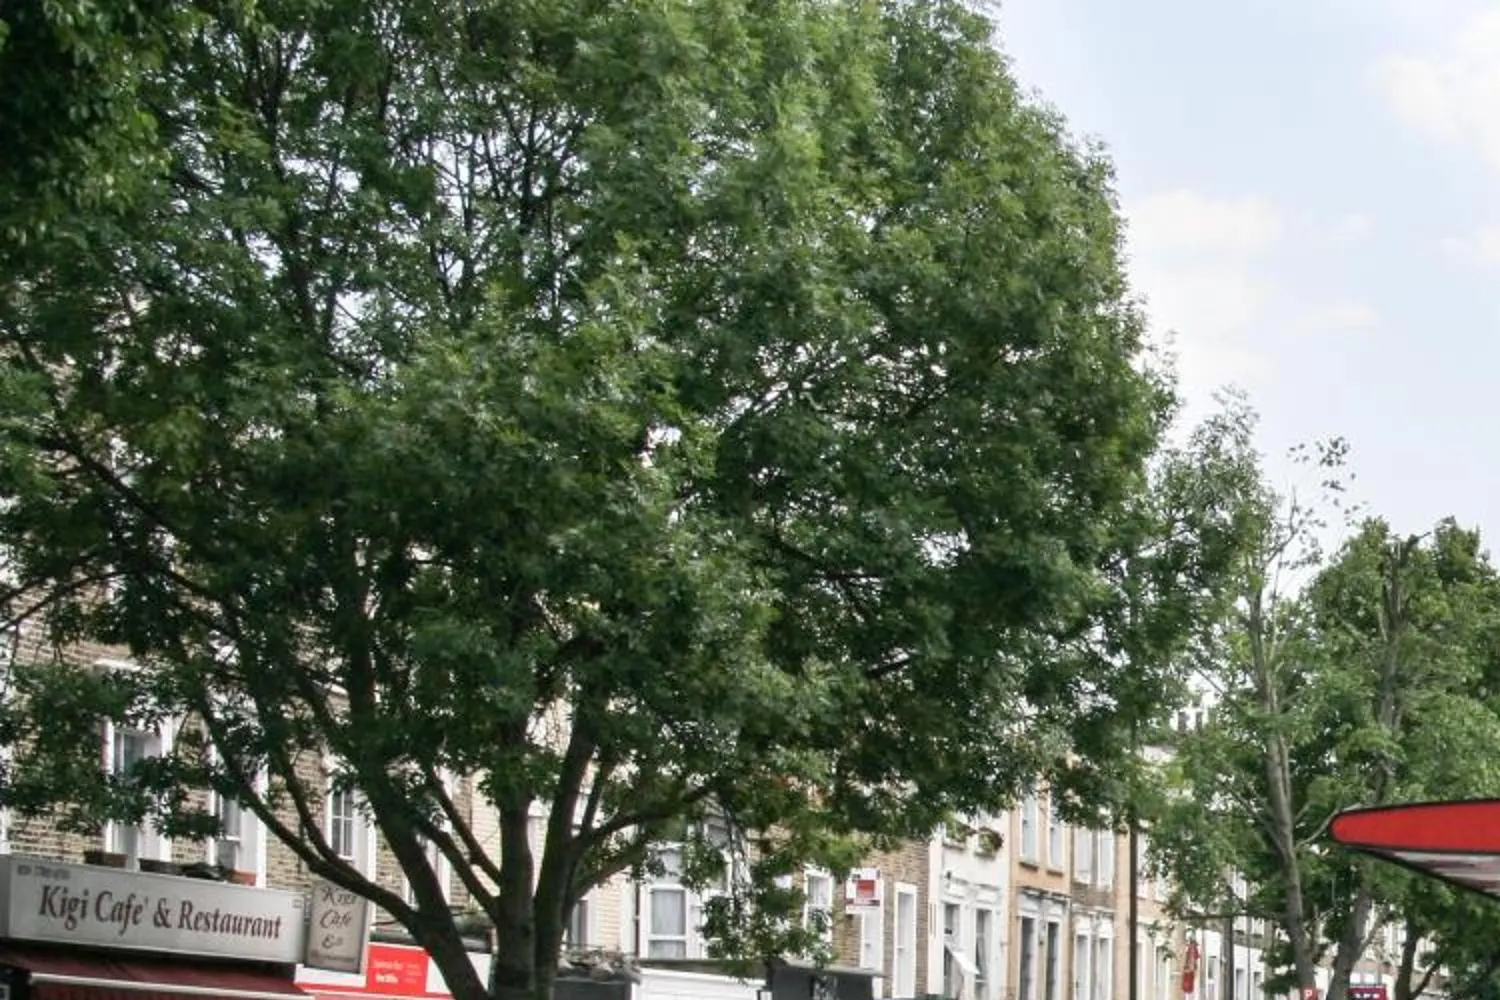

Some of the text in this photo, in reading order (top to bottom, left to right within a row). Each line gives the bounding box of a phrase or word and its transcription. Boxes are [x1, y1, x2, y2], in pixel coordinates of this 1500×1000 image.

[38, 884, 88, 932] Kigi
[153, 897, 172, 929] &
[178, 899, 283, 941] Restaurant
